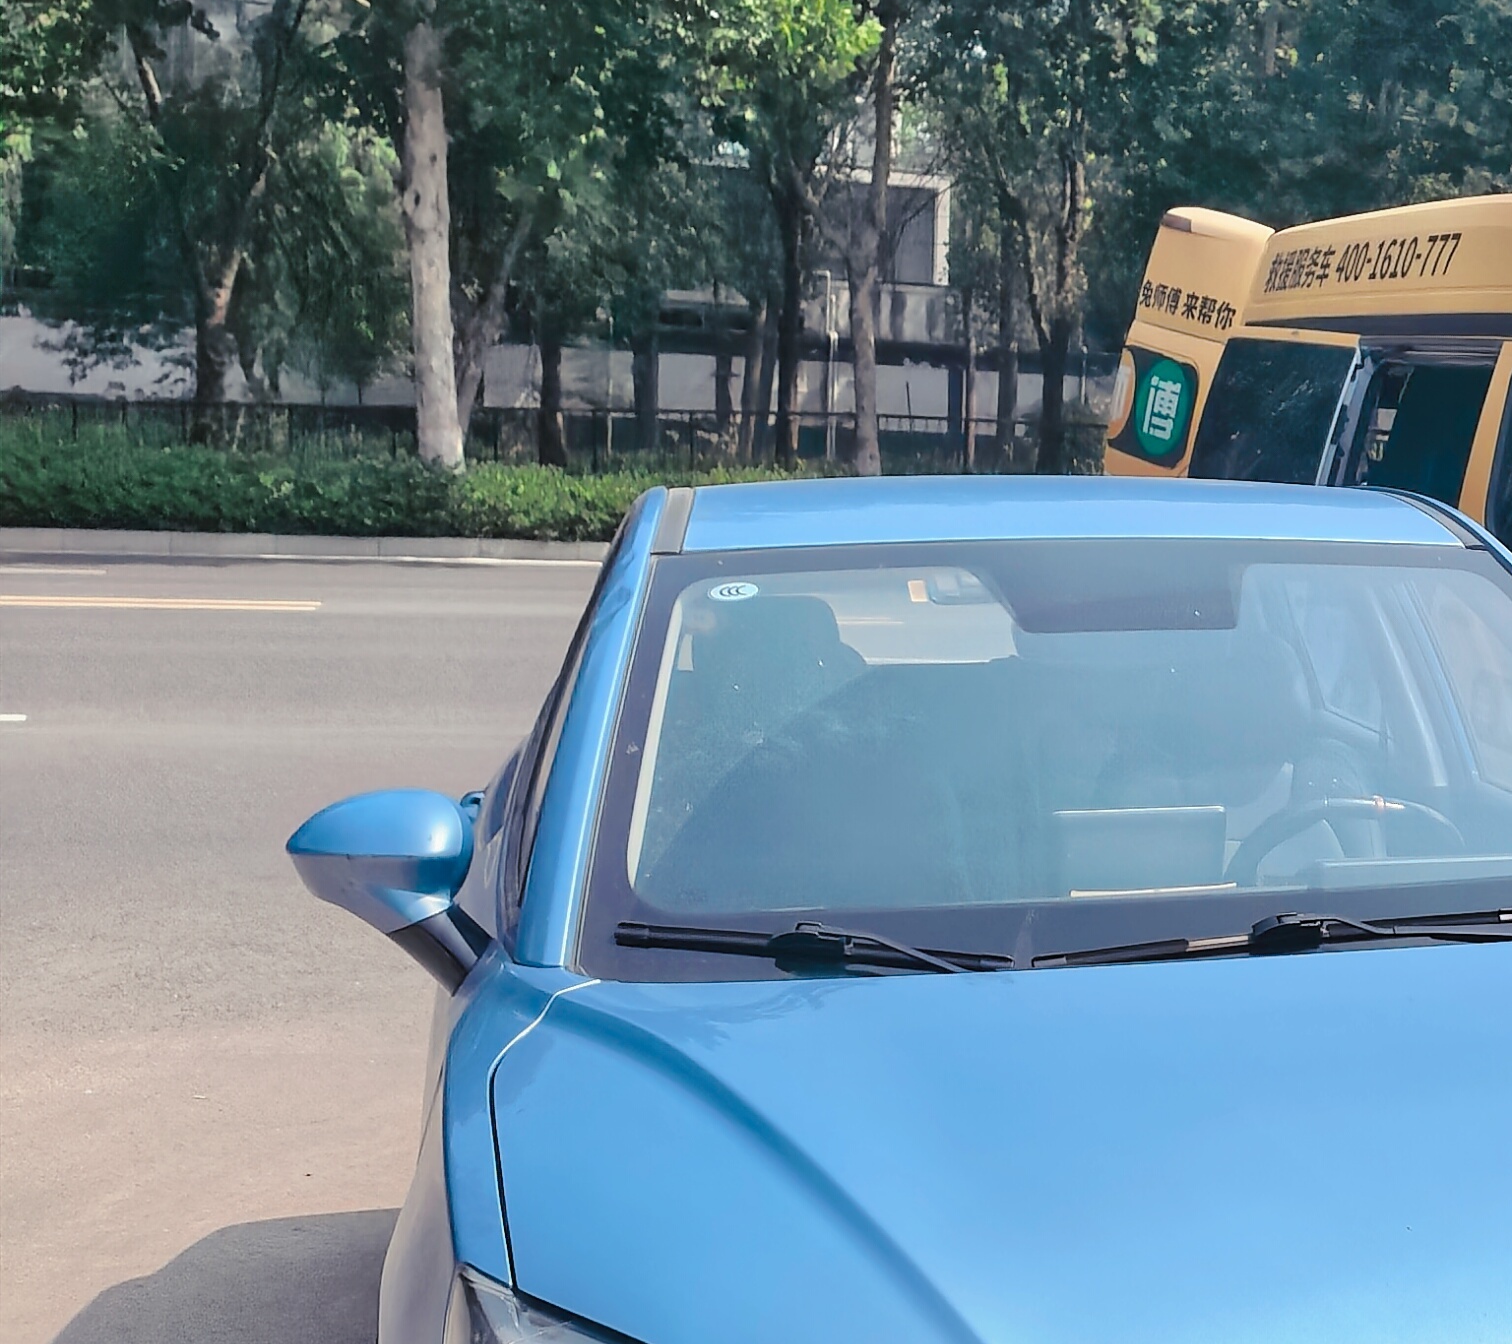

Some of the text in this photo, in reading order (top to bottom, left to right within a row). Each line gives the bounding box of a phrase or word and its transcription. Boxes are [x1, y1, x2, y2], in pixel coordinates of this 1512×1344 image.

[1264, 233, 1462, 293] 救援服务车 400-1610-777
[1139, 279, 1237, 331] 兔师傅 来帮你
